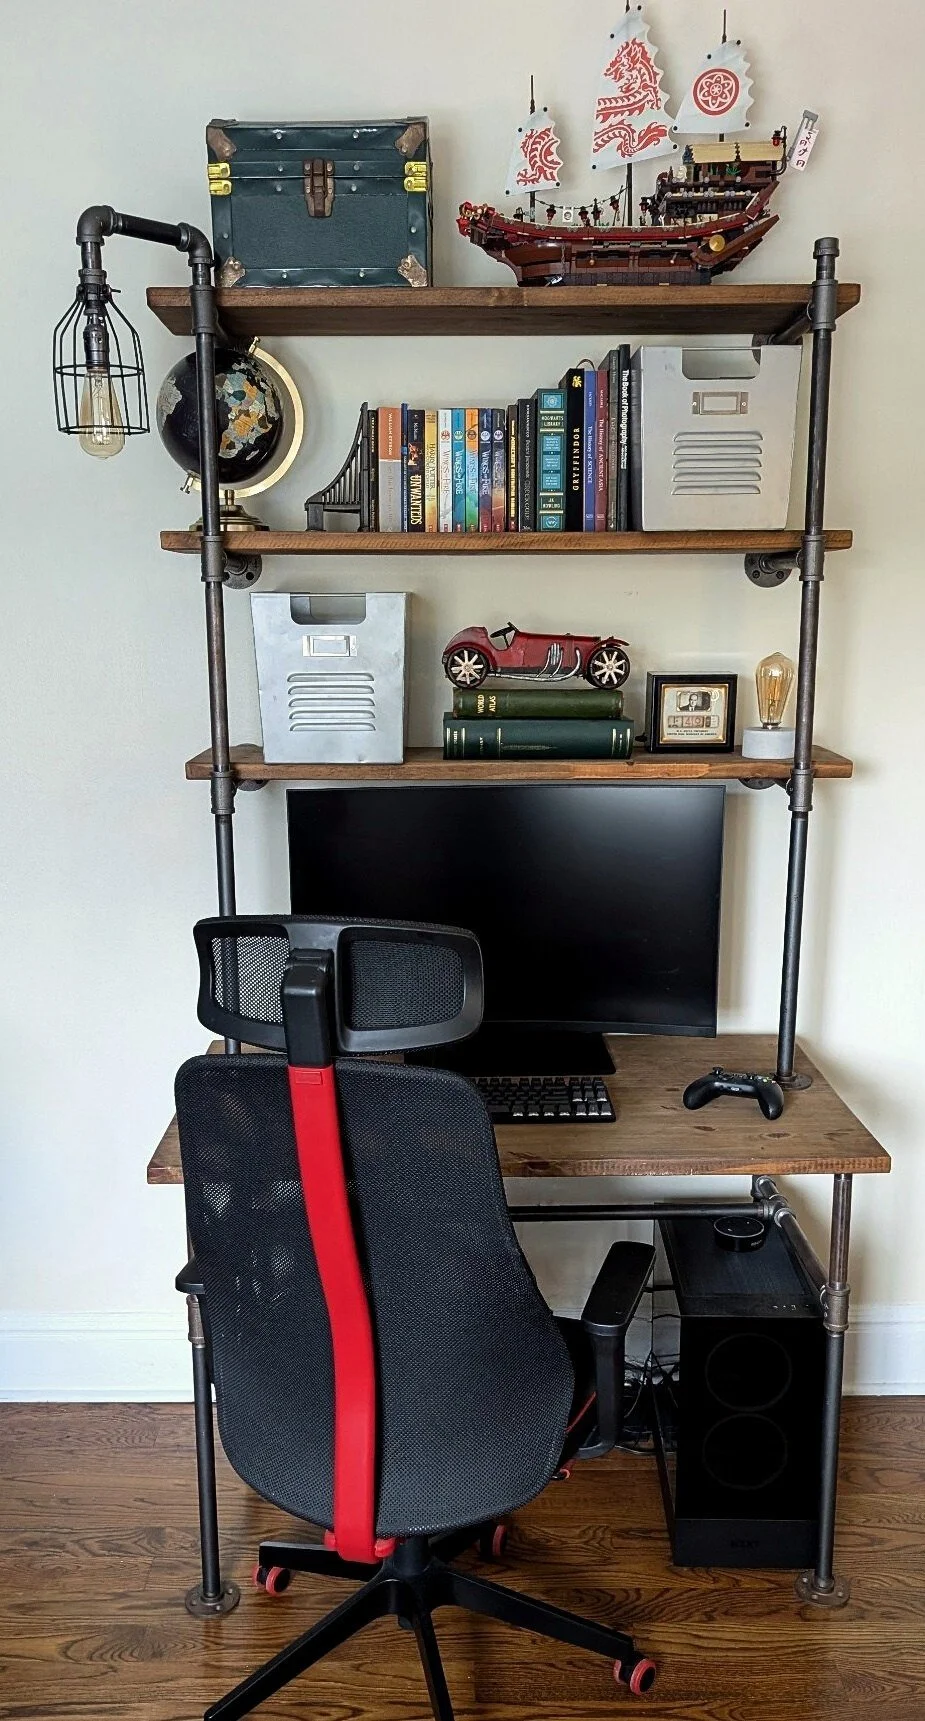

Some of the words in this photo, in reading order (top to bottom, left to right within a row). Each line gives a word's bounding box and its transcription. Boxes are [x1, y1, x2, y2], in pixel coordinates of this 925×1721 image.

[621, 382, 629, 398] Book
[620, 405, 628, 444] Photography
[442, 450, 451, 473] WINGS
[455, 450, 464, 473] WINGS
[469, 450, 477, 473] WINGS
[482, 450, 491, 473] WINGS
[442, 478, 451, 494] FIRE
[455, 478, 464, 494] FIRE
[469, 478, 477, 494] FIRE
[482, 479, 491, 494] FIRE
